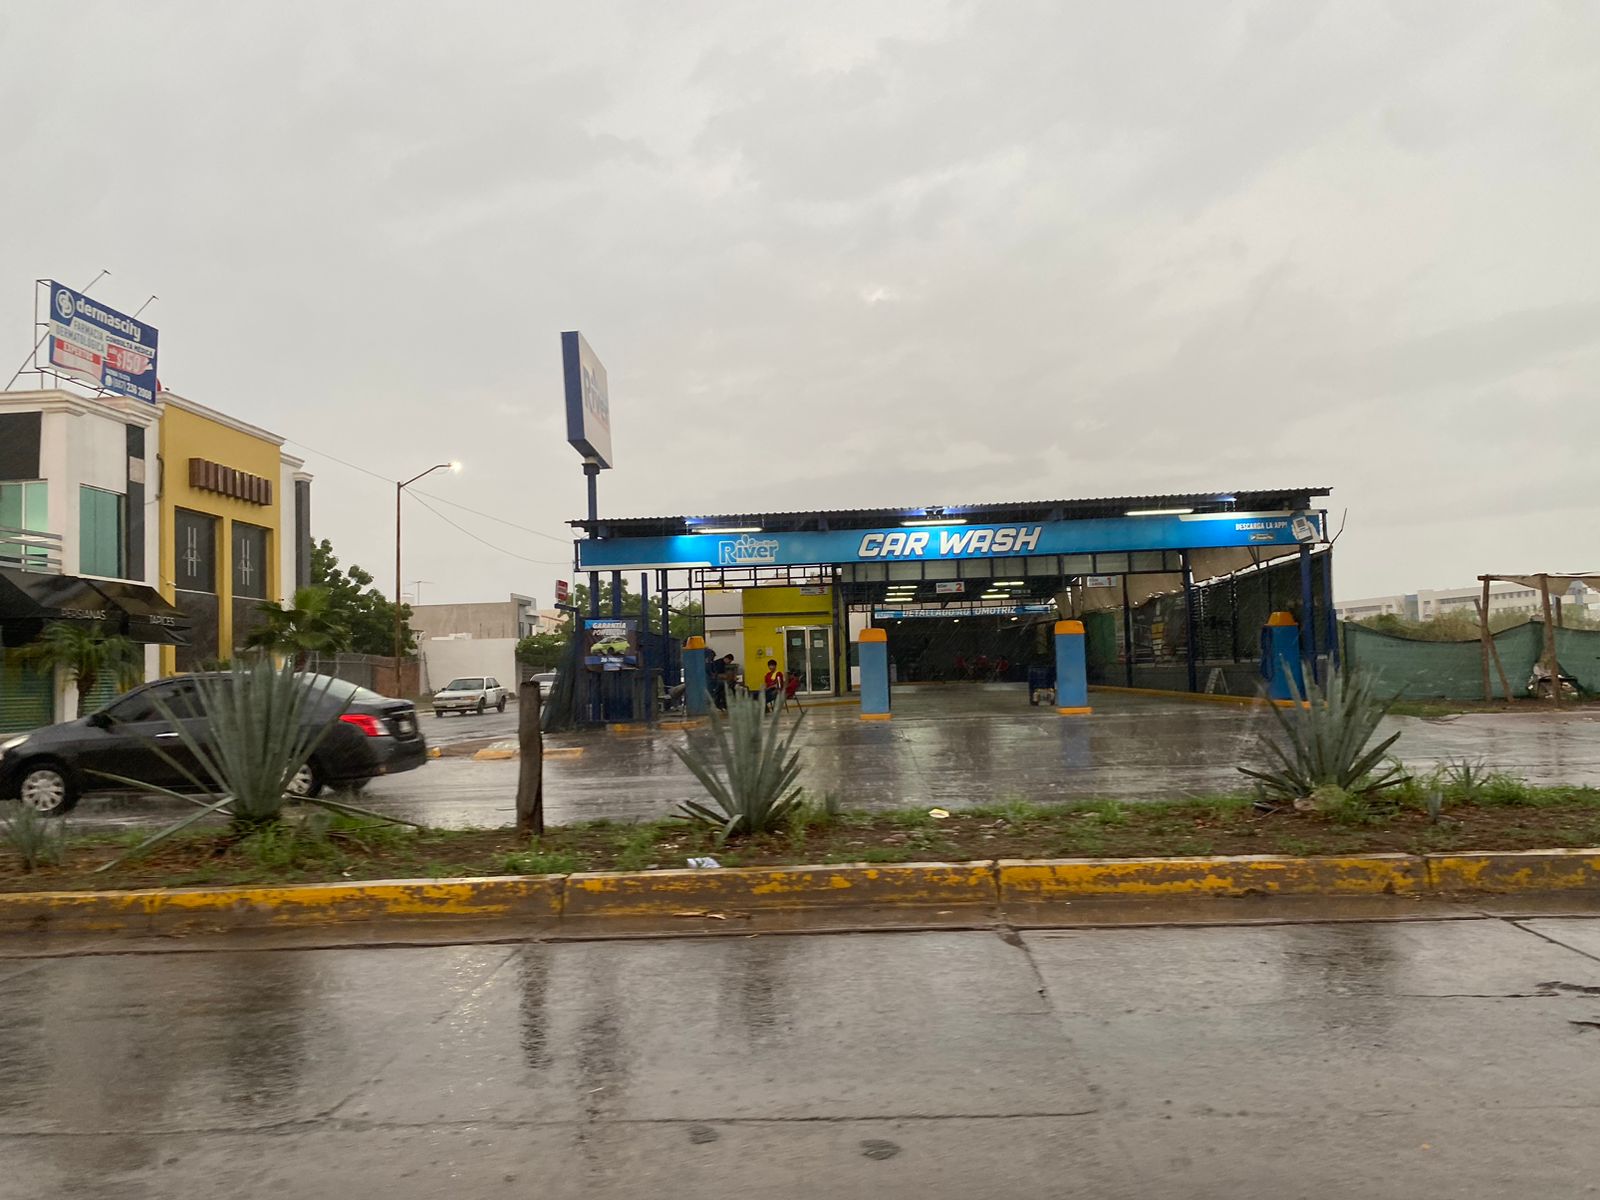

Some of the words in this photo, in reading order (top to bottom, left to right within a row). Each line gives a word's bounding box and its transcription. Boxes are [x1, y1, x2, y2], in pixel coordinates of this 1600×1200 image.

[76, 299, 141, 341] dermascity
[1235, 522, 1264, 530] DESCARGA
[858, 531, 929, 559] CAR
[939, 526, 1042, 556] WASH
[718, 539, 779, 564] River
[955, 582, 963, 592] 2
[956, 606, 1017, 616] AUOMOTRIZ
[149, 614, 175, 627] TAPICES
